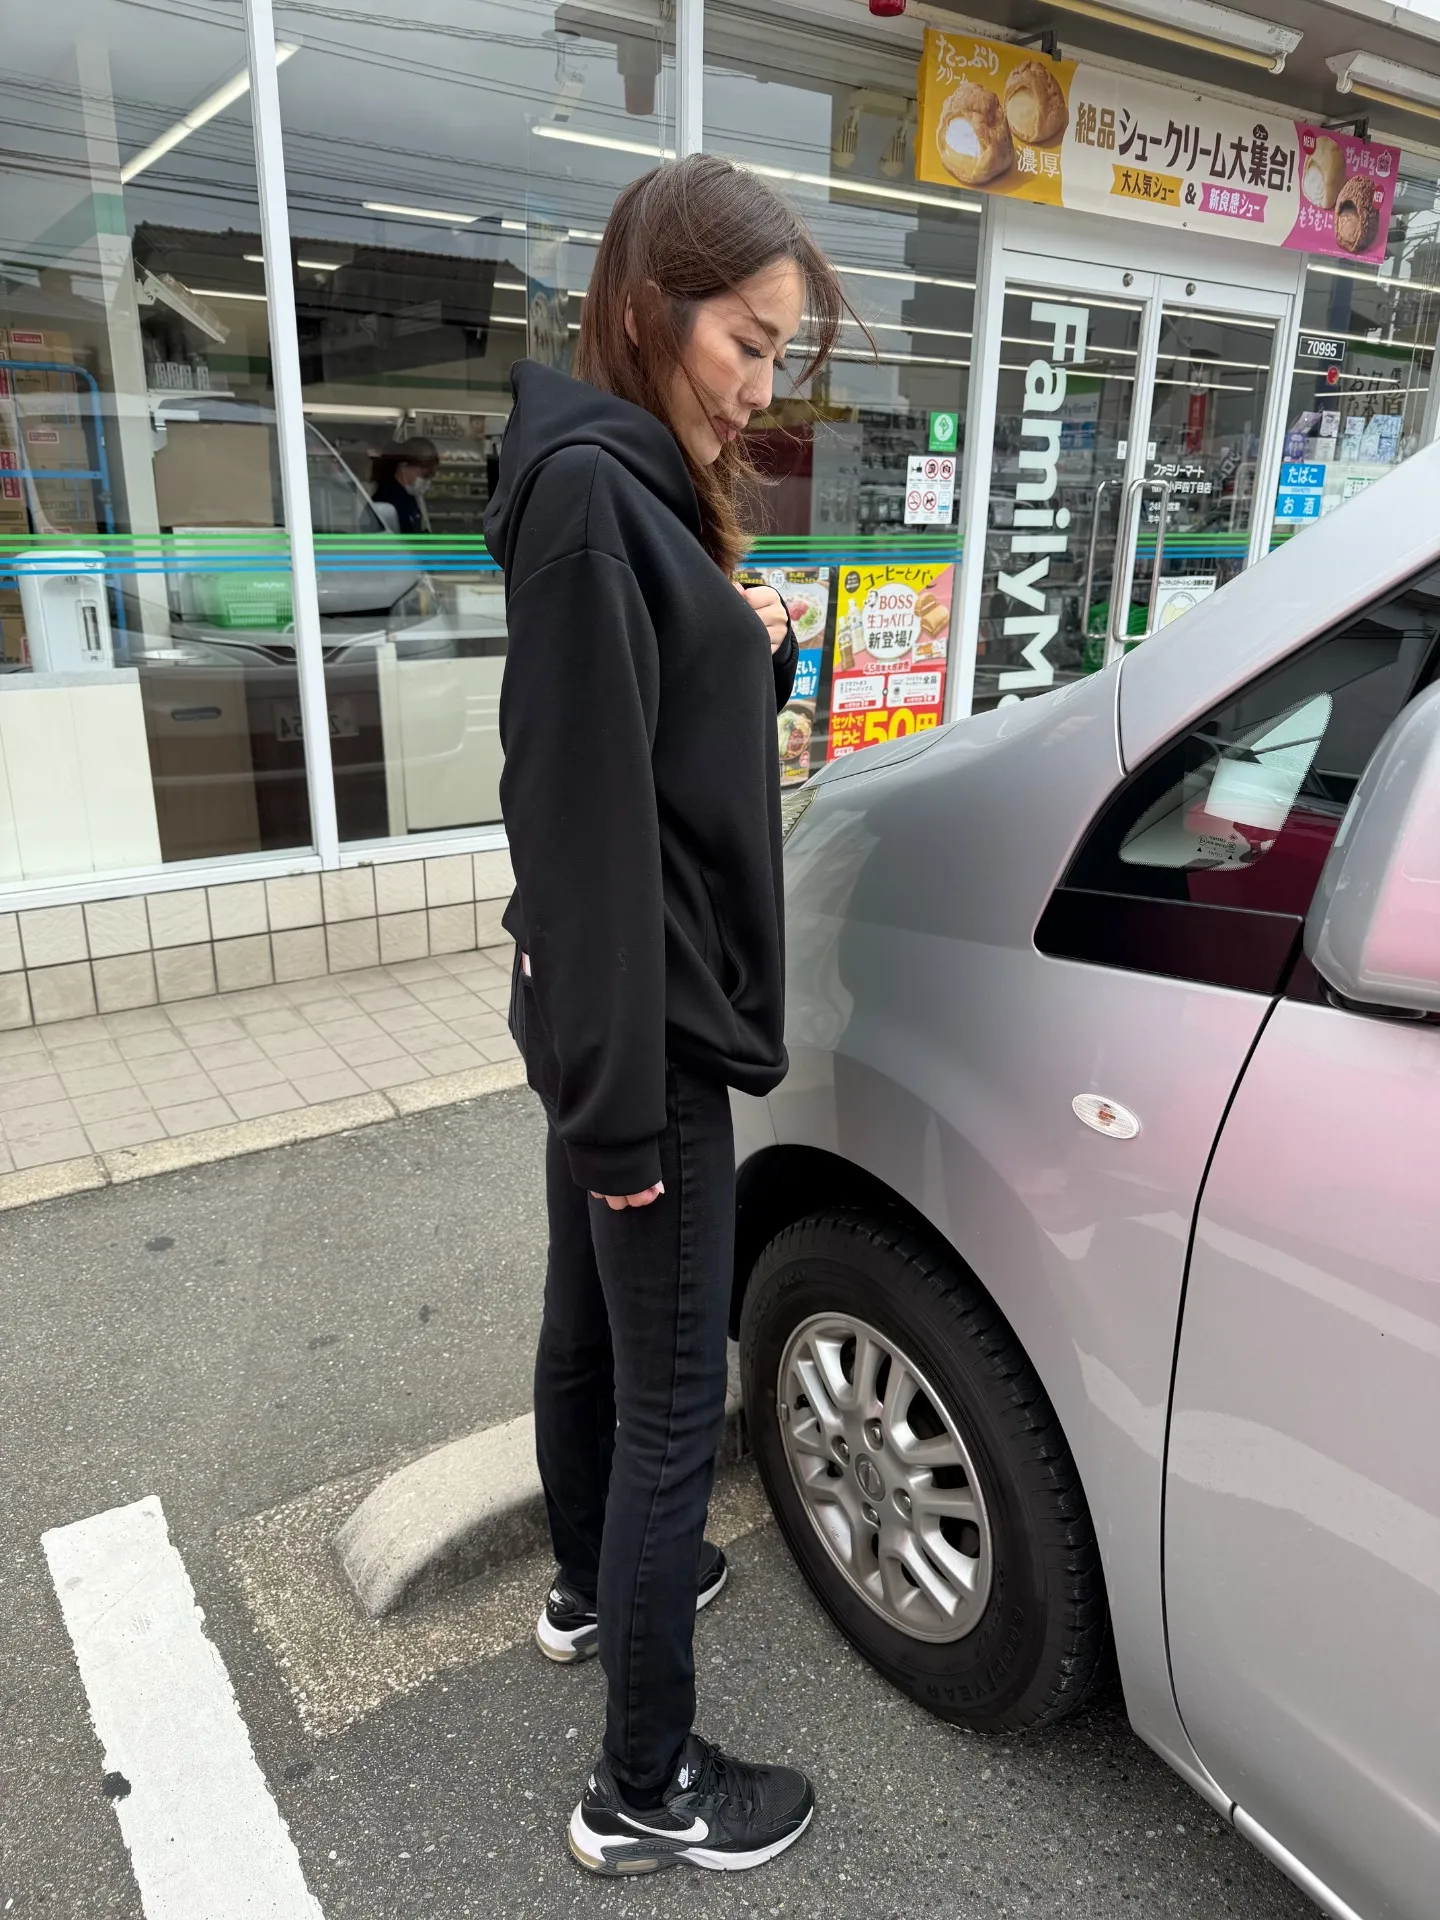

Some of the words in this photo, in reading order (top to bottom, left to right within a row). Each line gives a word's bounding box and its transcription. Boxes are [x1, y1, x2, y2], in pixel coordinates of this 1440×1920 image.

[936, 34, 999, 76] たっぷり
[1303, 134, 1316, 150] NEW
[1016, 145, 1060, 178] 濃厚
[1121, 169, 1175, 201] 大人気シュー
[1184, 182, 1196, 205] &
[1209, 187, 1261, 218] 新食感シュー
[1299, 205, 1334, 232] もちむに
[1306, 340, 1338, 357] 70995
[1153, 463, 1205, 479] ファミリーマート
[1287, 465, 1318, 484] たばこ
[863, 565, 937, 592] コーヒーとパン
[880, 594, 914, 610] BOSS
[867, 613, 914, 630] 生コッペパン
[868, 630, 913, 651] 新登場!
[831, 713, 865, 730] セットで
[832, 730, 861, 748] 買うと
